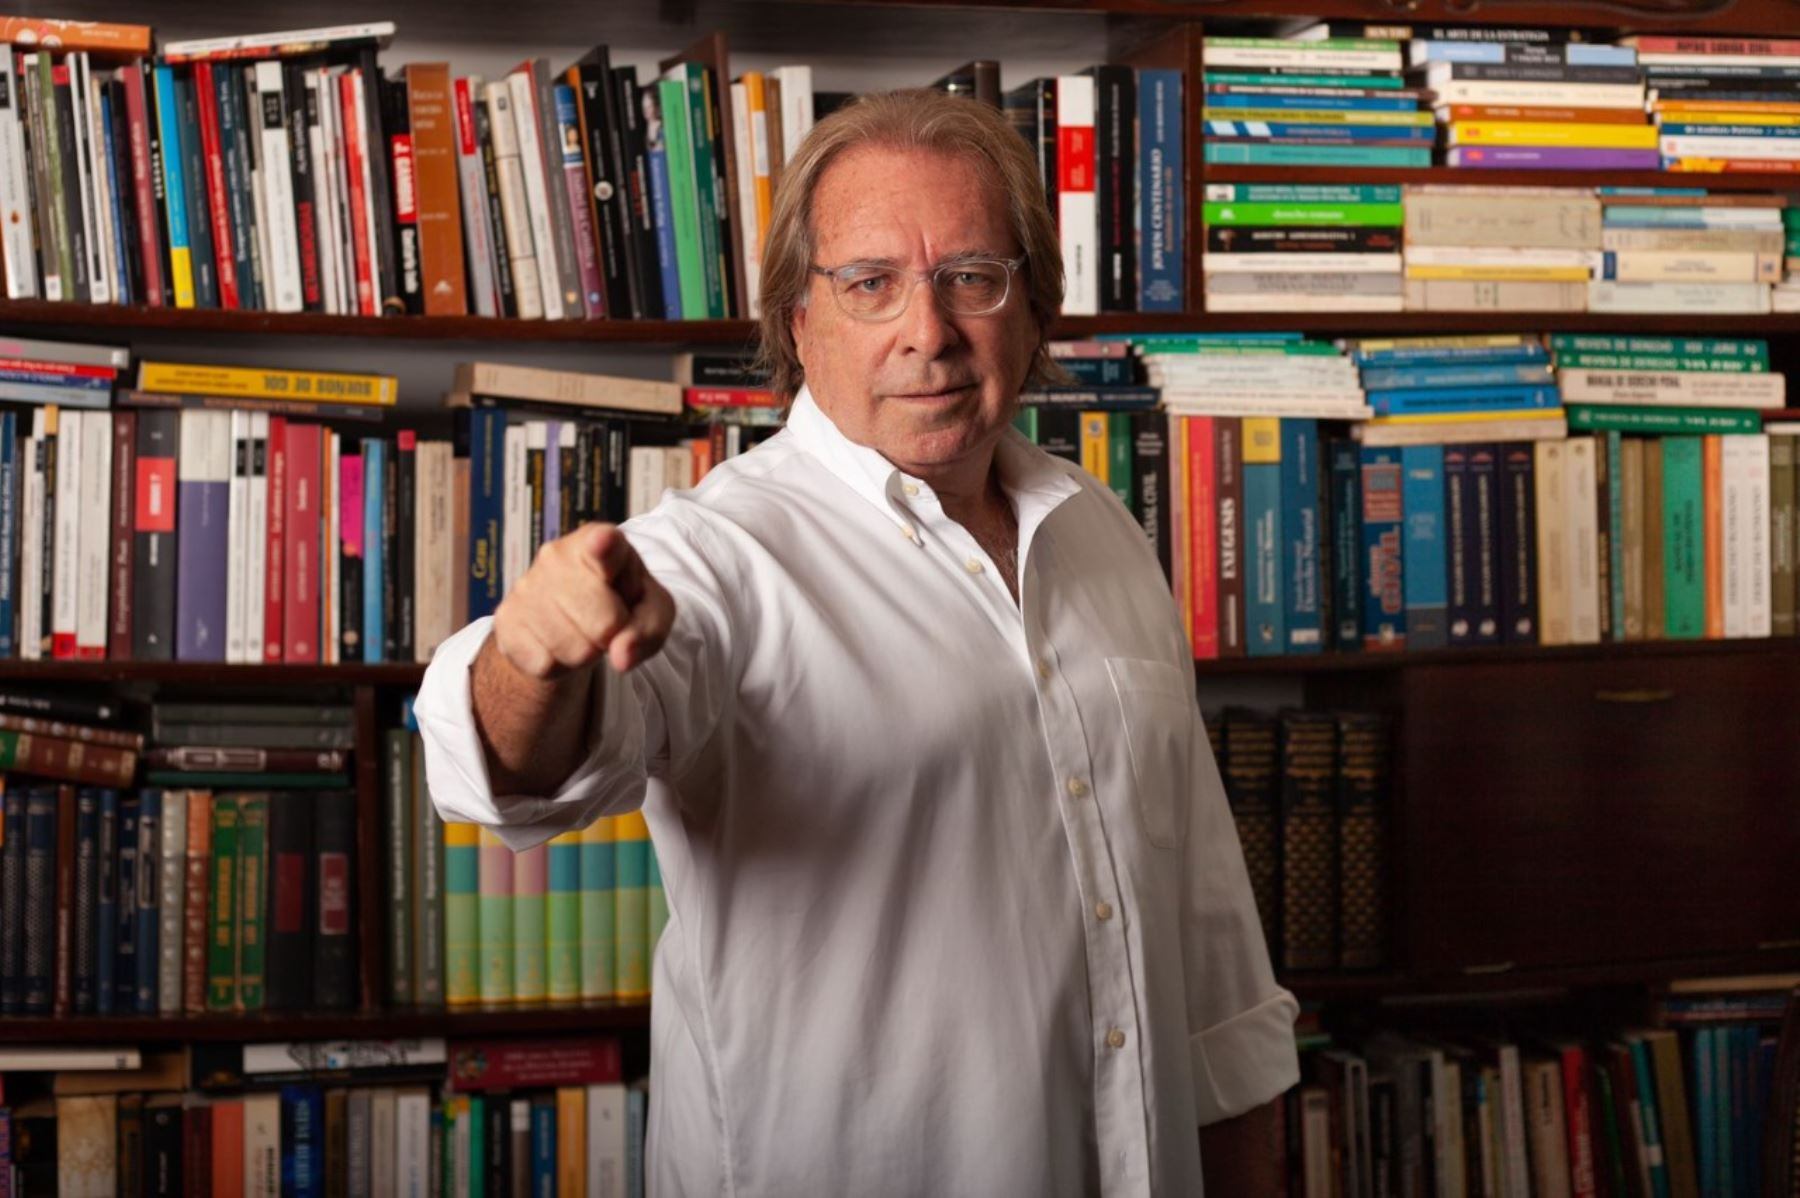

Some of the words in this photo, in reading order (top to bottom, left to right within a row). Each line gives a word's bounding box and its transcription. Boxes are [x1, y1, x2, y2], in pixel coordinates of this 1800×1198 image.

[1150, 147, 1164, 229] CENTENARIO
[1152, 230, 1165, 271] JOVEN
[1221, 496, 1237, 580] EXEGESIS
